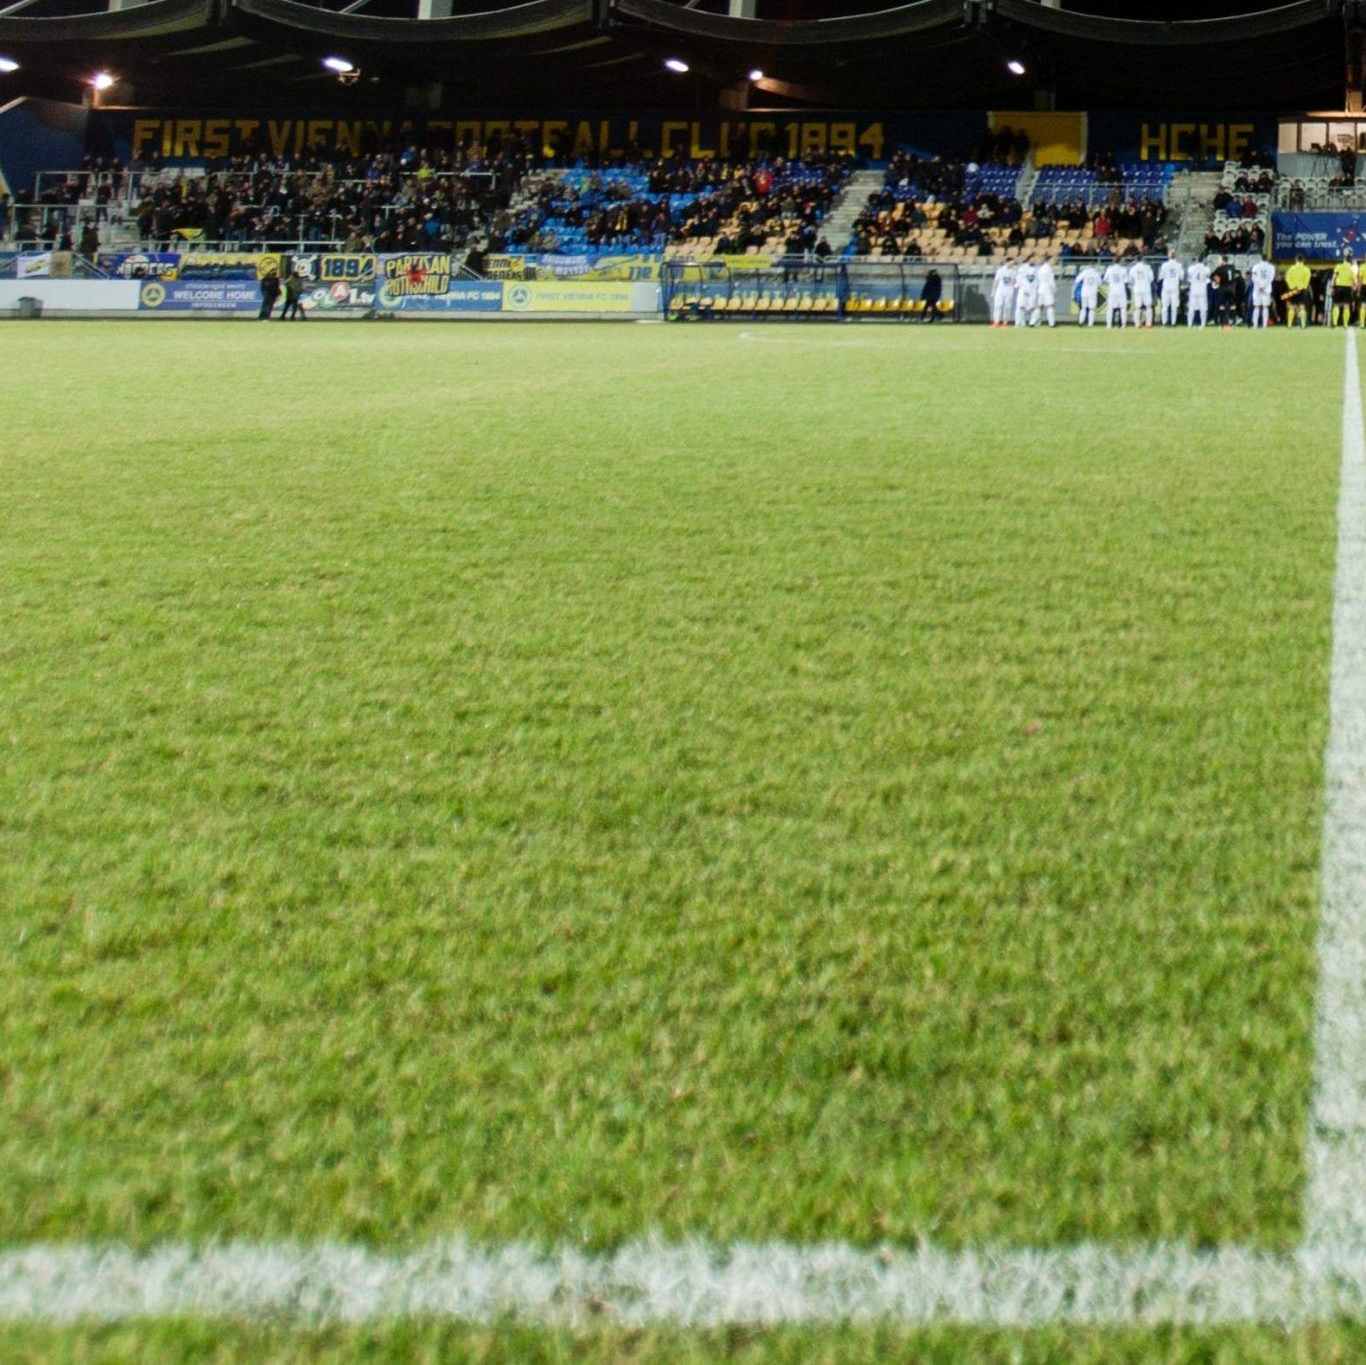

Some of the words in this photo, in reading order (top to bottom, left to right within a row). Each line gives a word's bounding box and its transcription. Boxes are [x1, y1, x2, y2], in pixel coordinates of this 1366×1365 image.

[132, 119, 259, 157] FIRST
[267, 120, 413, 157] VIEN
[785, 122, 884, 159] 1894
[325, 259, 375, 278] 1894
[174, 291, 223, 300] WELCOME
[226, 291, 256, 300] HOME
